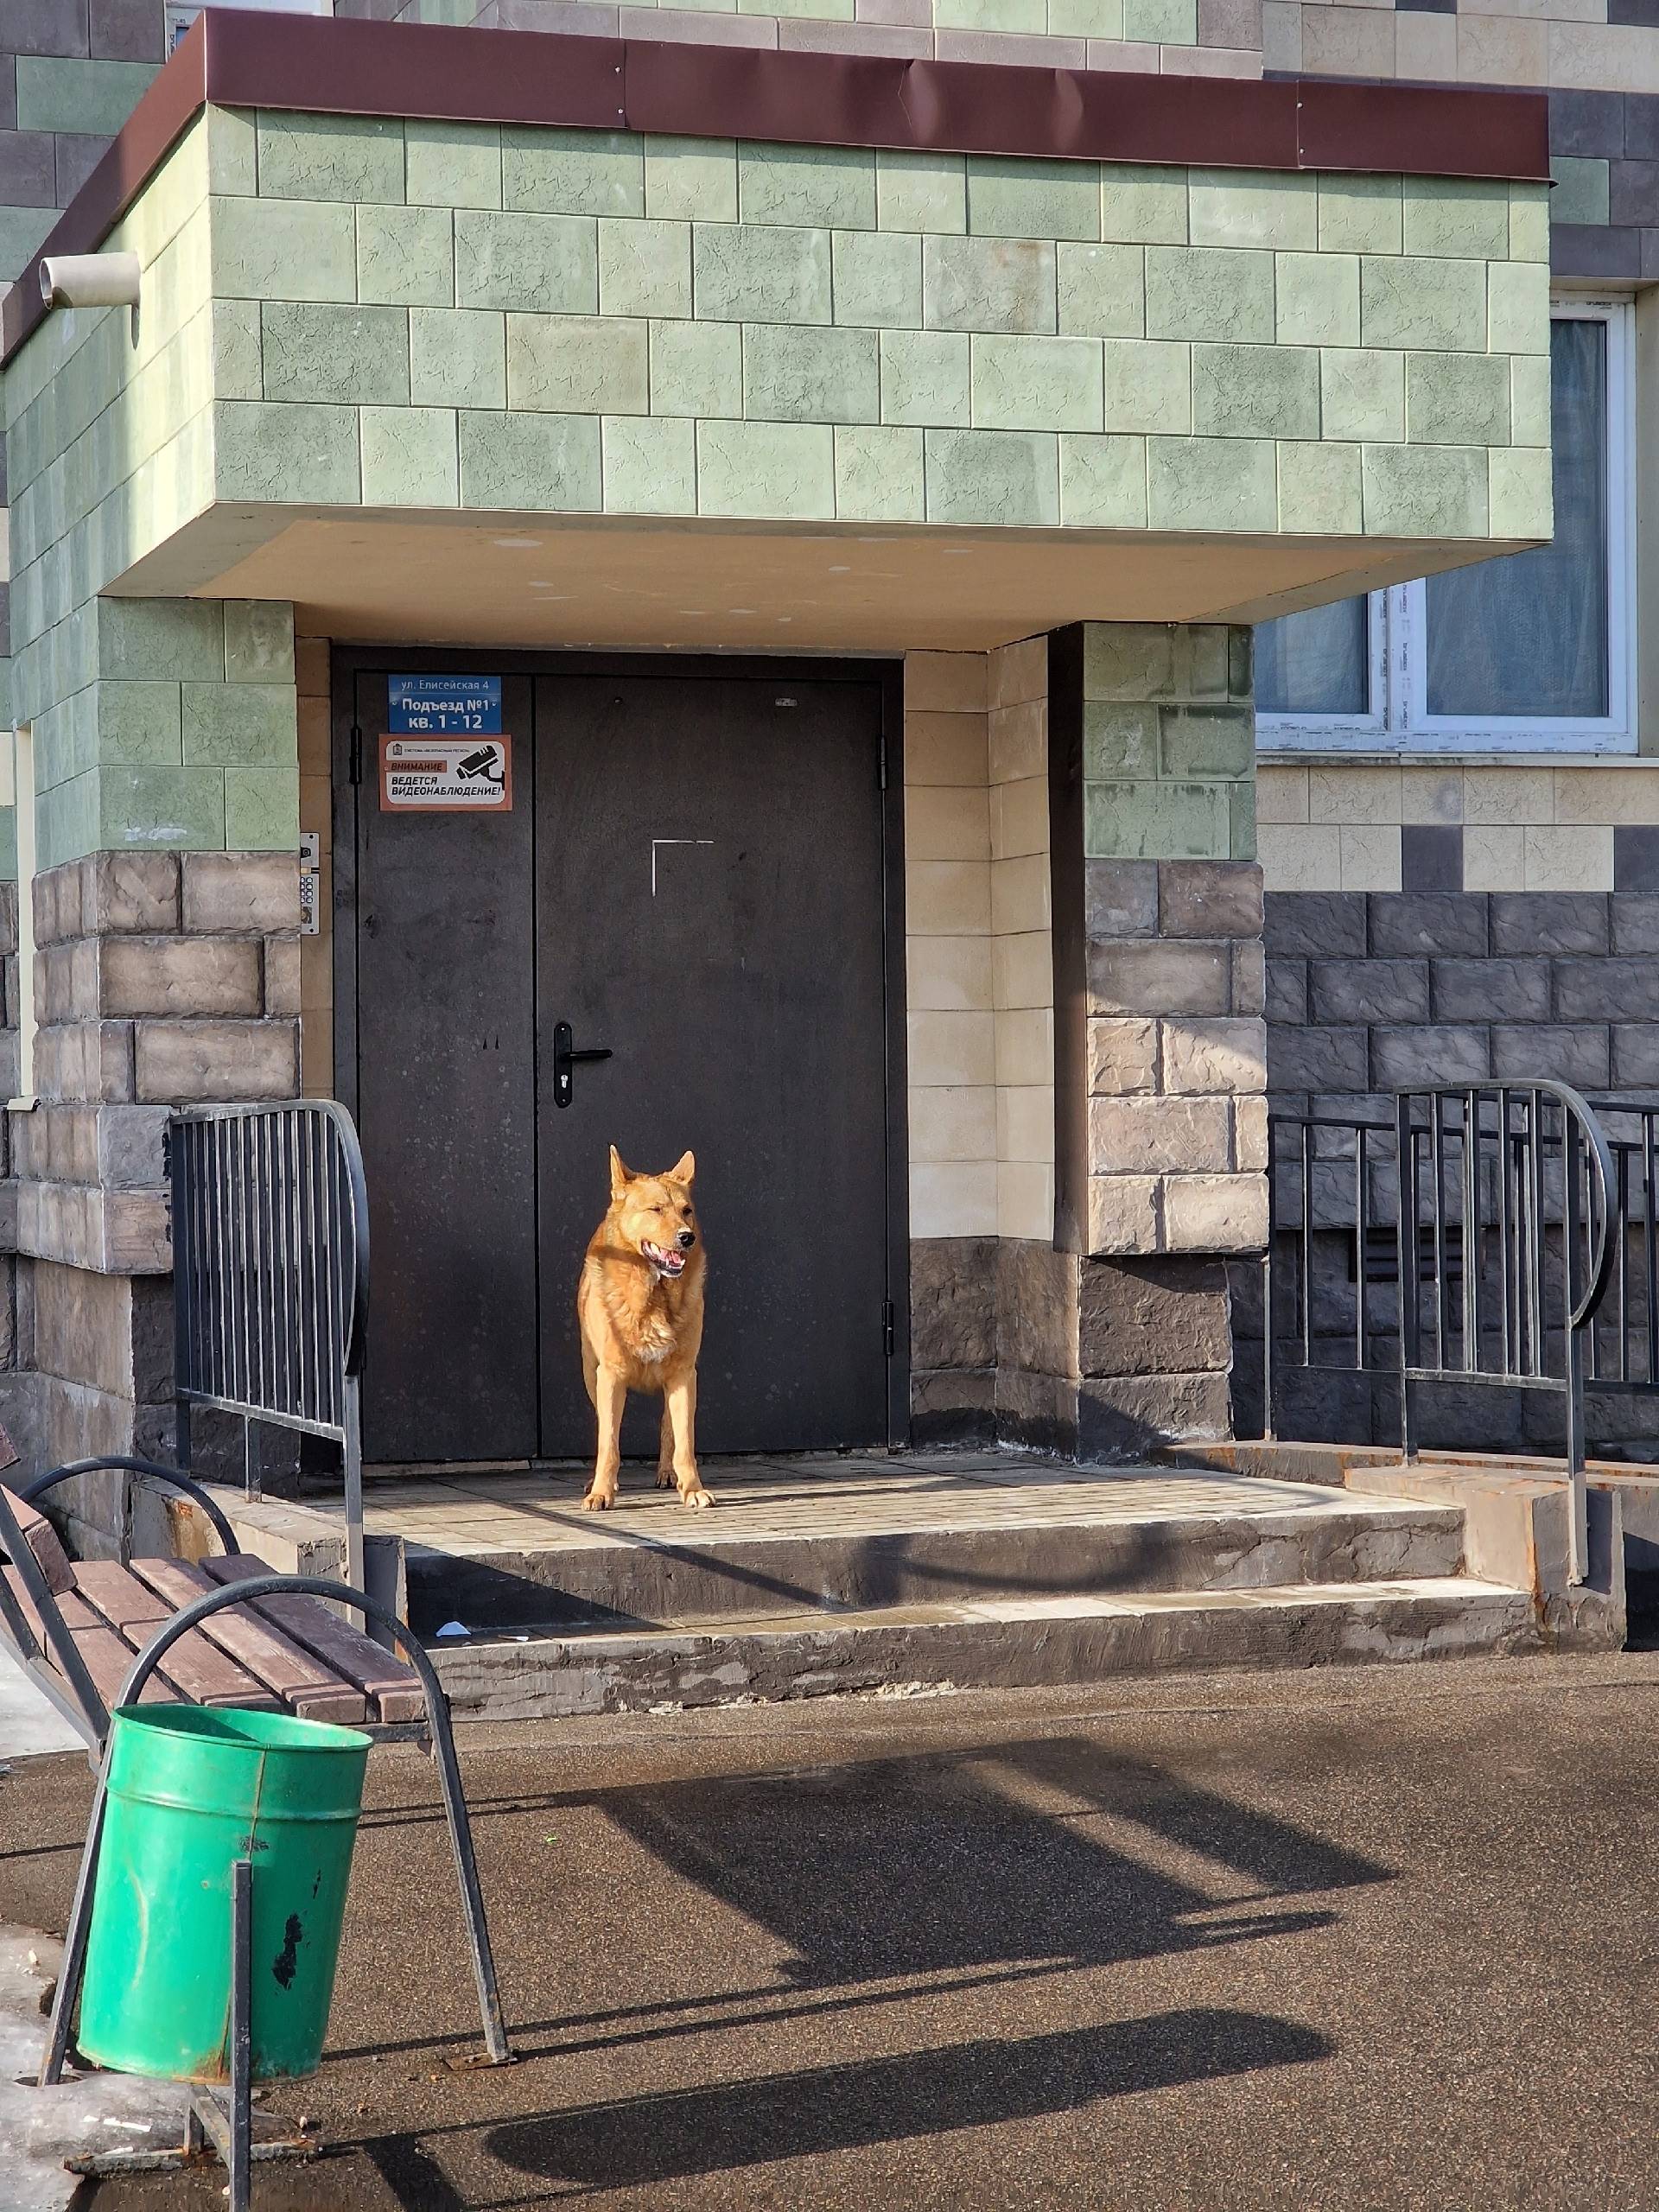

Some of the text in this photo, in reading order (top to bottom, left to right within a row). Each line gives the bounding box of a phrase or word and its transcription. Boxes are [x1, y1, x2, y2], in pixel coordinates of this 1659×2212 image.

[401, 679, 489, 690] ул. Елисейская 4
[402, 698, 489, 713] Подъезд №1
[409, 717, 433, 728] кв.
[438, 715, 446, 728] 1
[463, 715, 482, 728] 12
[391, 777, 437, 786] ВЕДЕТСЯ
[391, 787, 500, 797] ВИДЕОНАБЛЮДЕНИЕ!
